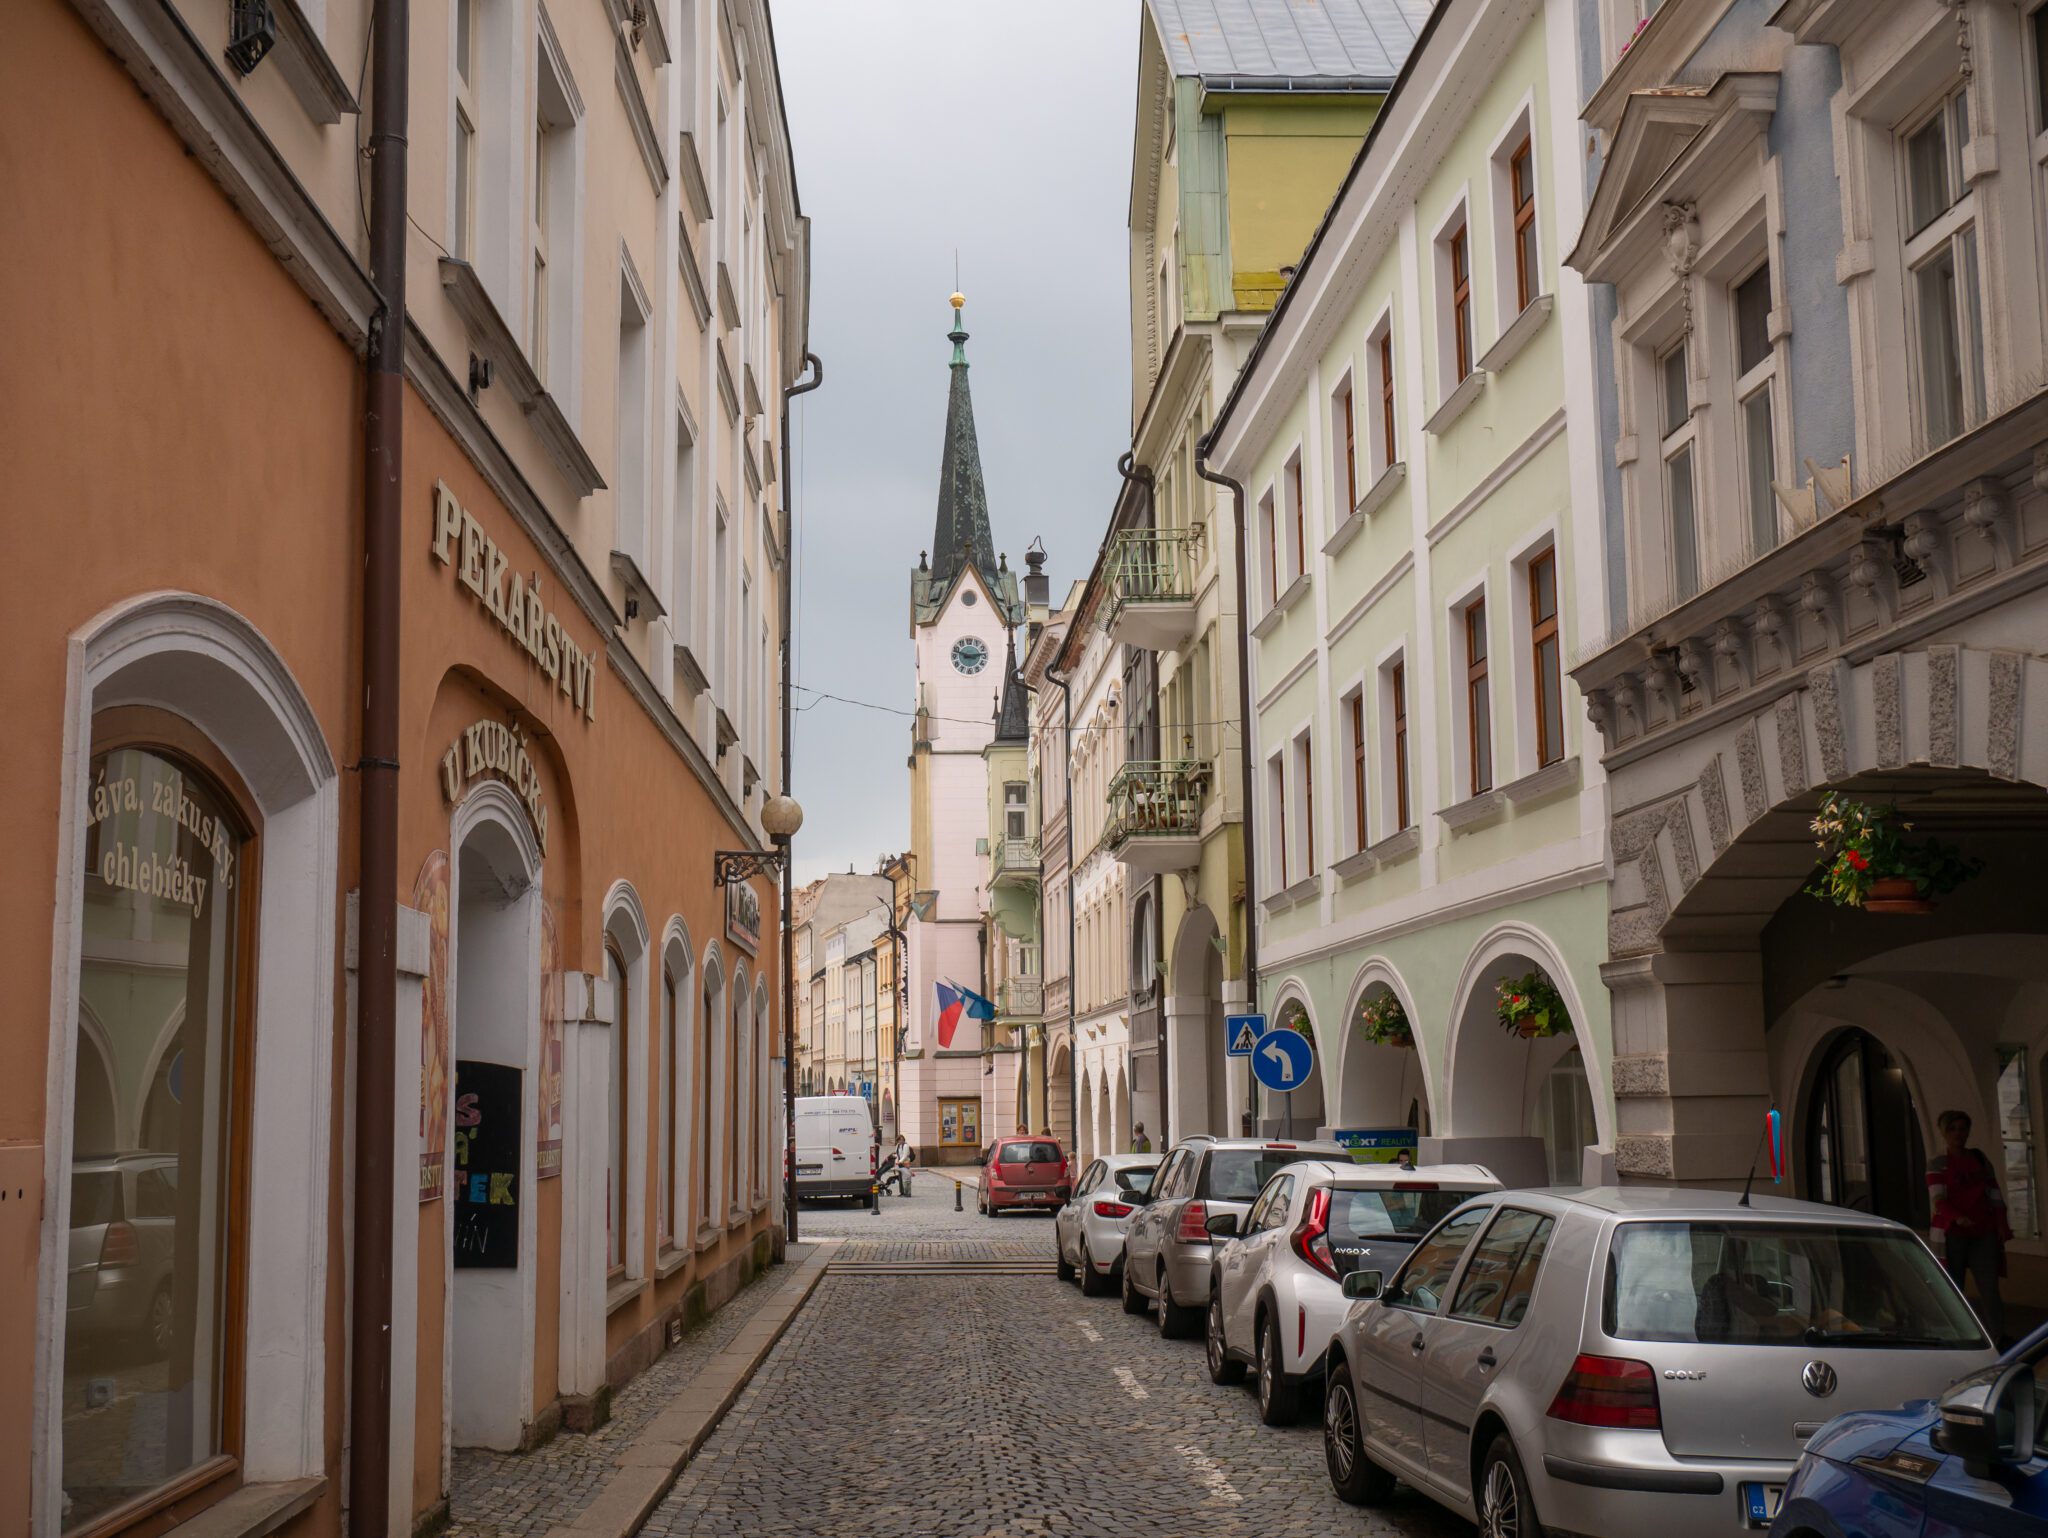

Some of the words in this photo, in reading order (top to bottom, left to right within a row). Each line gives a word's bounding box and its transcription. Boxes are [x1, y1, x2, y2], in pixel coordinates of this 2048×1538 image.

[433, 478, 597, 722] PEKAŘSTVÍ
[442, 738, 462, 802] U
[464, 718, 549, 858] KUBÍČKA
[87, 768, 145, 827] áva,
[152, 773, 234, 890] zákusky,
[103, 842, 207, 919] chlebíčky
[1380, 1138, 1411, 1146] REALITY
[1334, 1247, 1360, 1255] AYGO
[1360, 1247, 1371, 1256] X
[1663, 1369, 1707, 1381] GOLF
[1752, 1505, 1765, 1515] CZ
